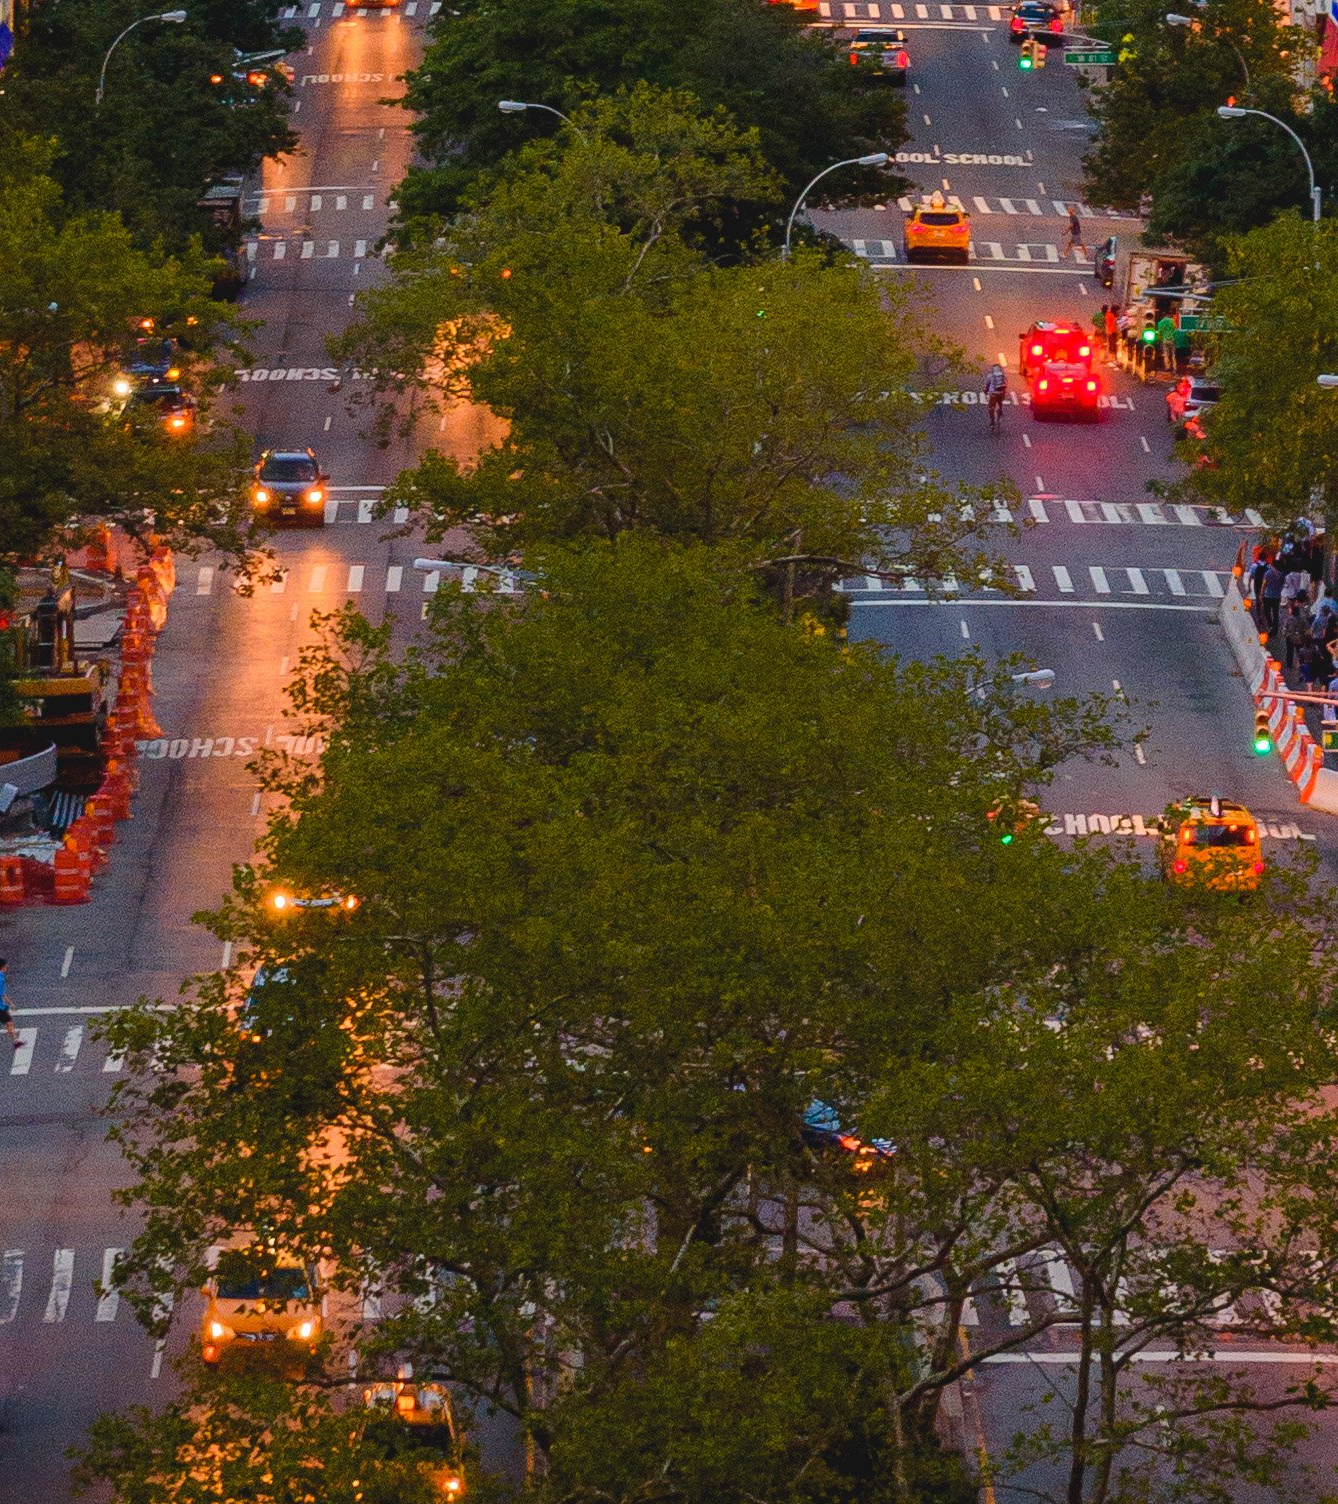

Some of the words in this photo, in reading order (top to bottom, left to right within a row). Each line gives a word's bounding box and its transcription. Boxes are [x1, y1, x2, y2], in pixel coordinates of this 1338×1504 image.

[895, 152, 940, 164] OOL
[943, 153, 1033, 166] SCHOOL
[234, 367, 339, 382] SCHOOL
